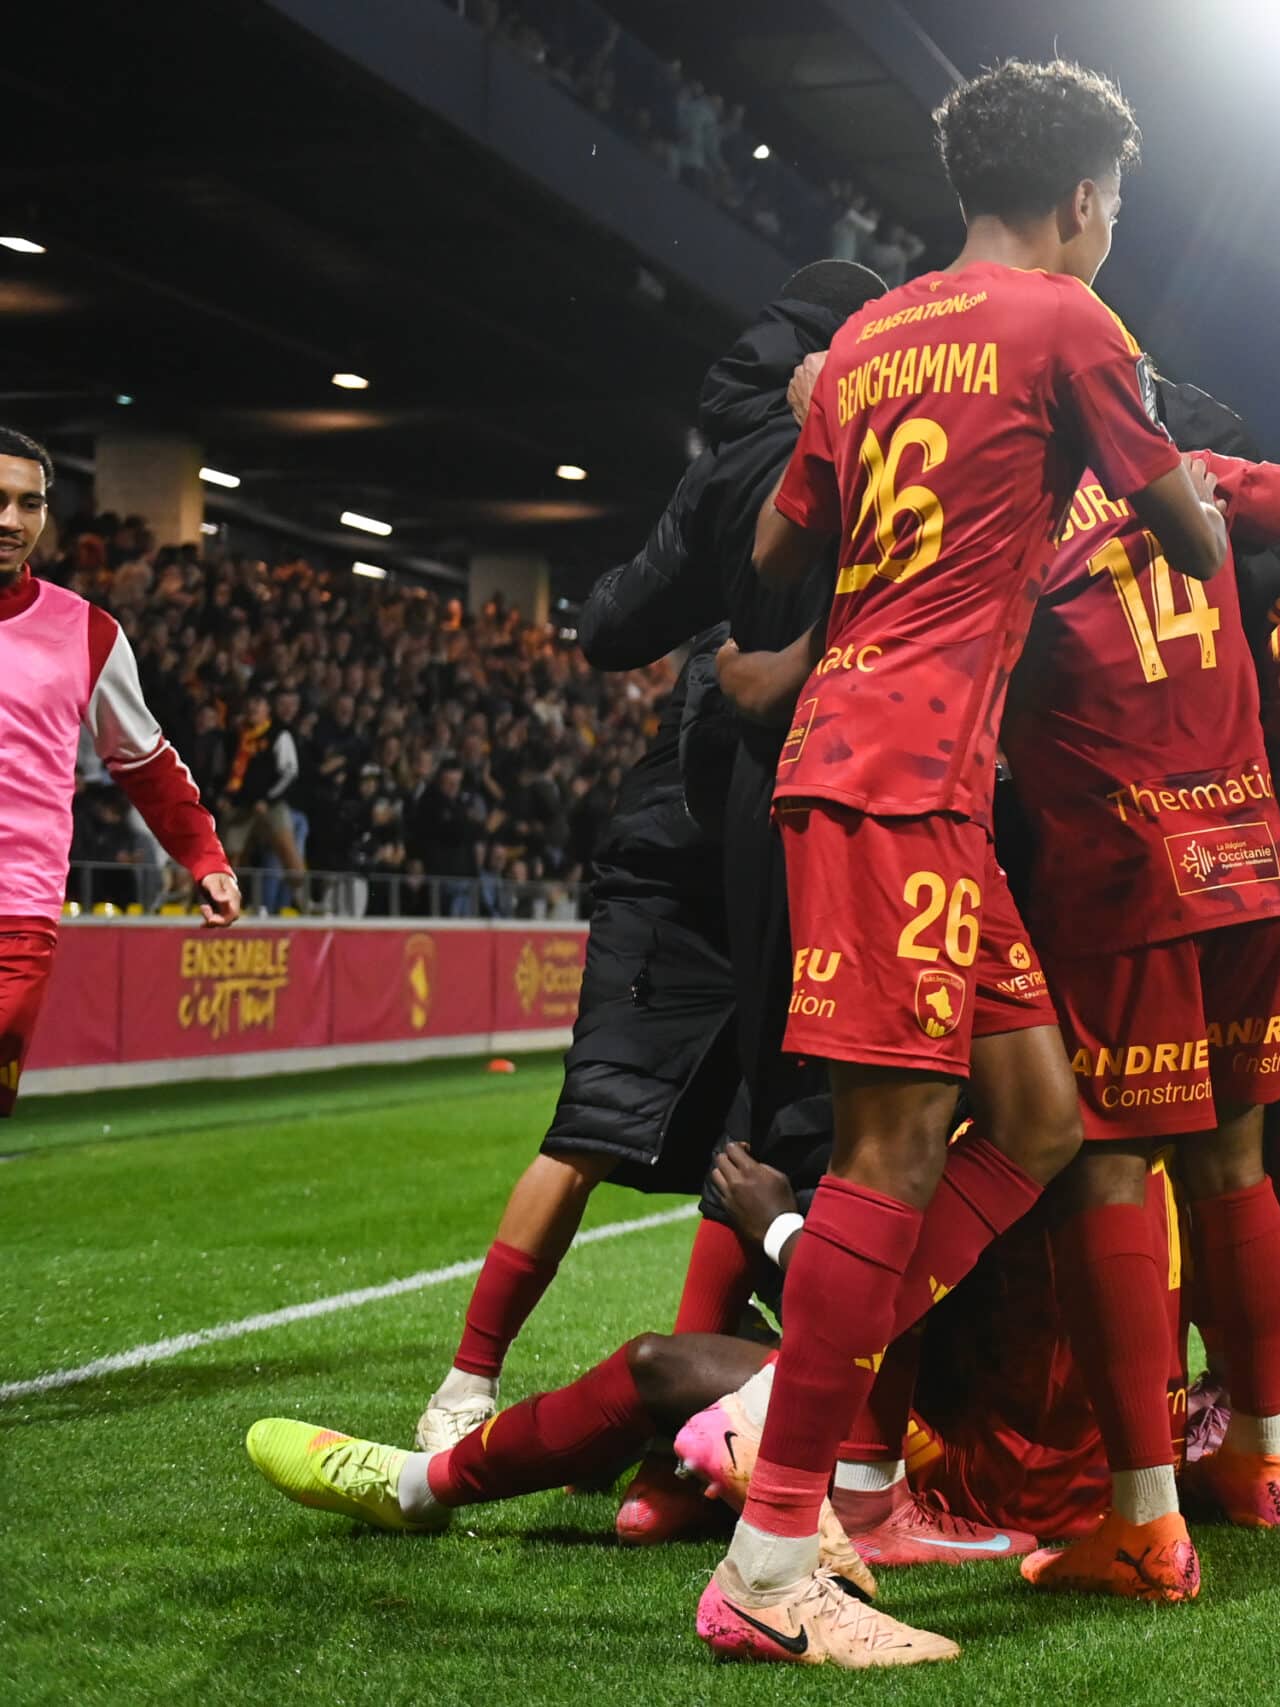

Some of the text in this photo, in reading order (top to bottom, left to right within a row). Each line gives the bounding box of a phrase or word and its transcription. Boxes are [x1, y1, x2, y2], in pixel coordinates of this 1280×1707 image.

[837, 342, 999, 428] BENCHAMMA
[835, 417, 949, 595] 26
[1085, 529, 1222, 684] 14
[1218, 844, 1272, 863] Occitanie
[181, 938, 290, 978] ENSEMBLE
[896, 870, 982, 968] 26
